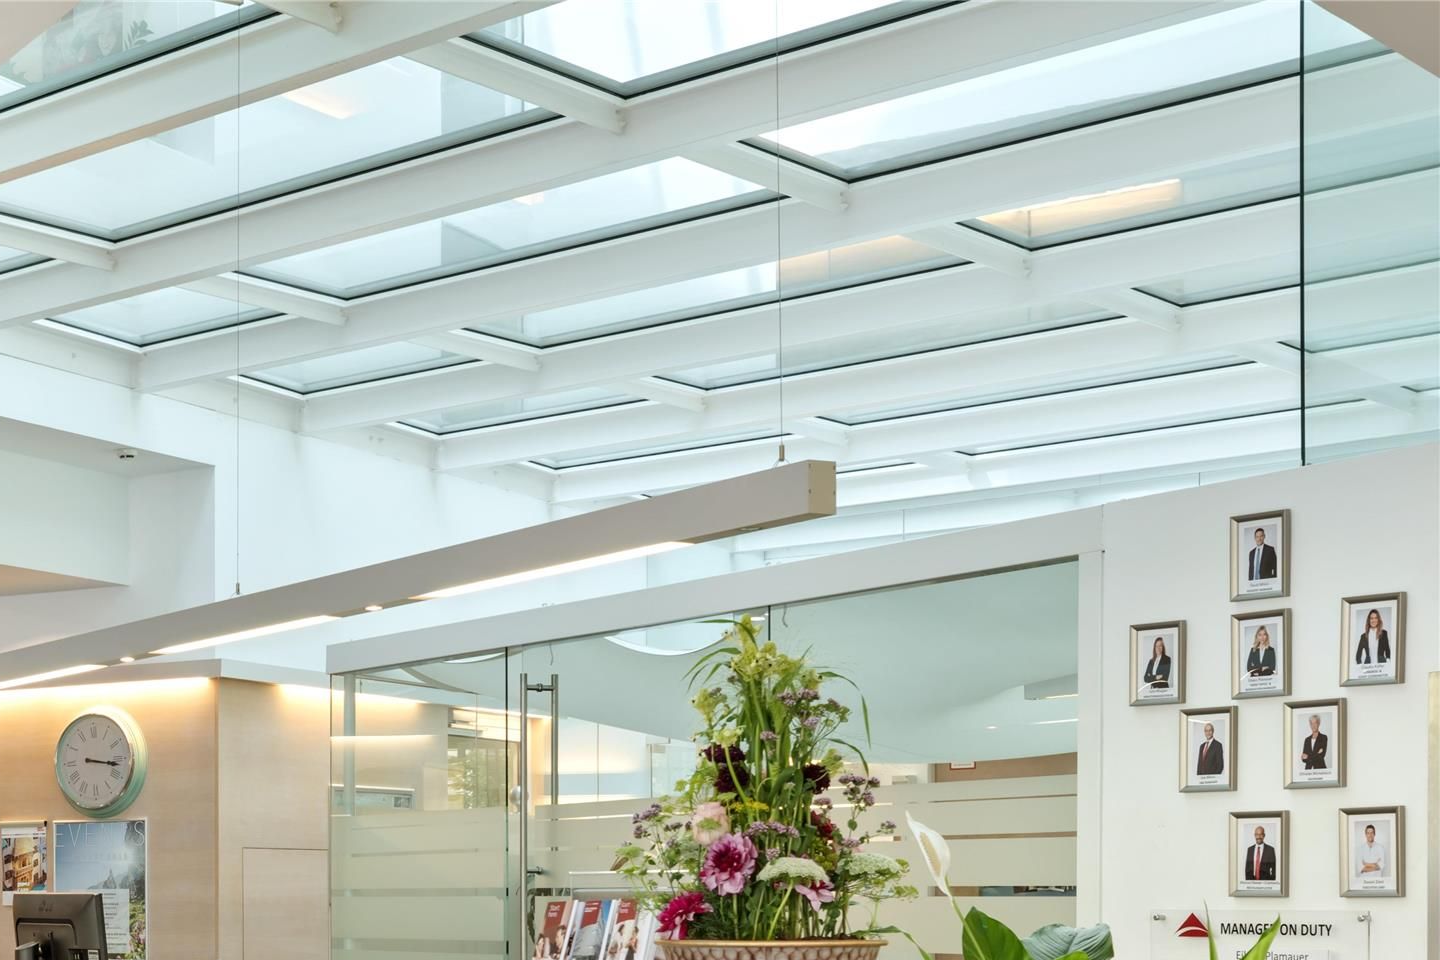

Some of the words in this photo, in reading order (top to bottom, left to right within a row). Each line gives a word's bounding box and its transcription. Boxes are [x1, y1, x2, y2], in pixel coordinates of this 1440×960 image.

[1220, 922, 1275, 936] MANAGE
[1279, 923, 1297, 936] ON
[1300, 923, 1333, 937] DUTY
